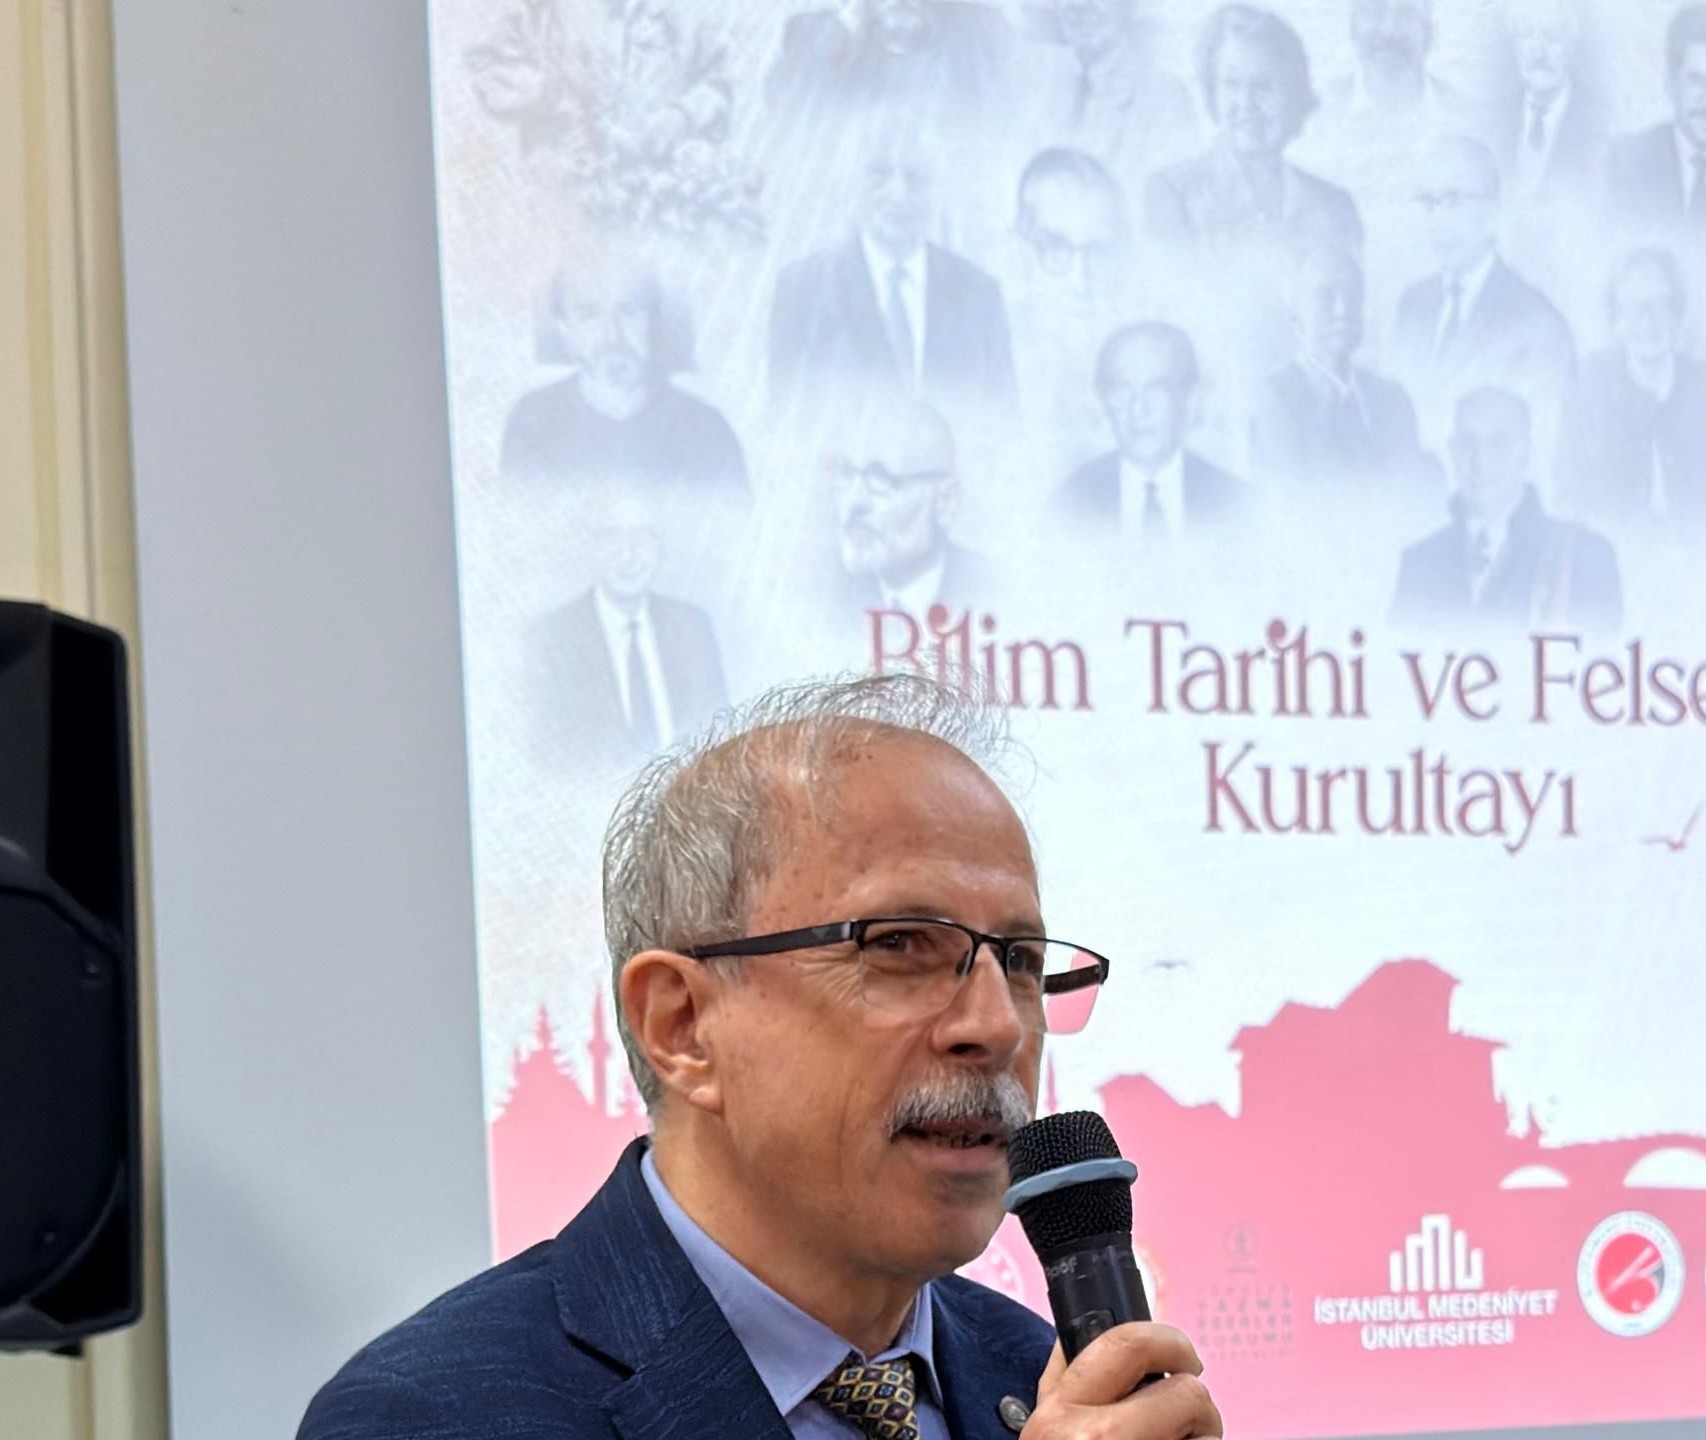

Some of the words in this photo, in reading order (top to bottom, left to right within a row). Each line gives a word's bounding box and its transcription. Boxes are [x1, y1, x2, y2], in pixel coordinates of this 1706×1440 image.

[866, 604, 1093, 710] Bilim
[1123, 618, 1369, 717] Tarihi
[1400, 649, 1498, 719] ve
[1202, 741, 1578, 856] Kurultayı
[1314, 1295, 1424, 1324] İSTANBUL
[1428, 1288, 1557, 1319] MEDENİYET
[1361, 1318, 1514, 1350] ÜNİVERSİTESİ
